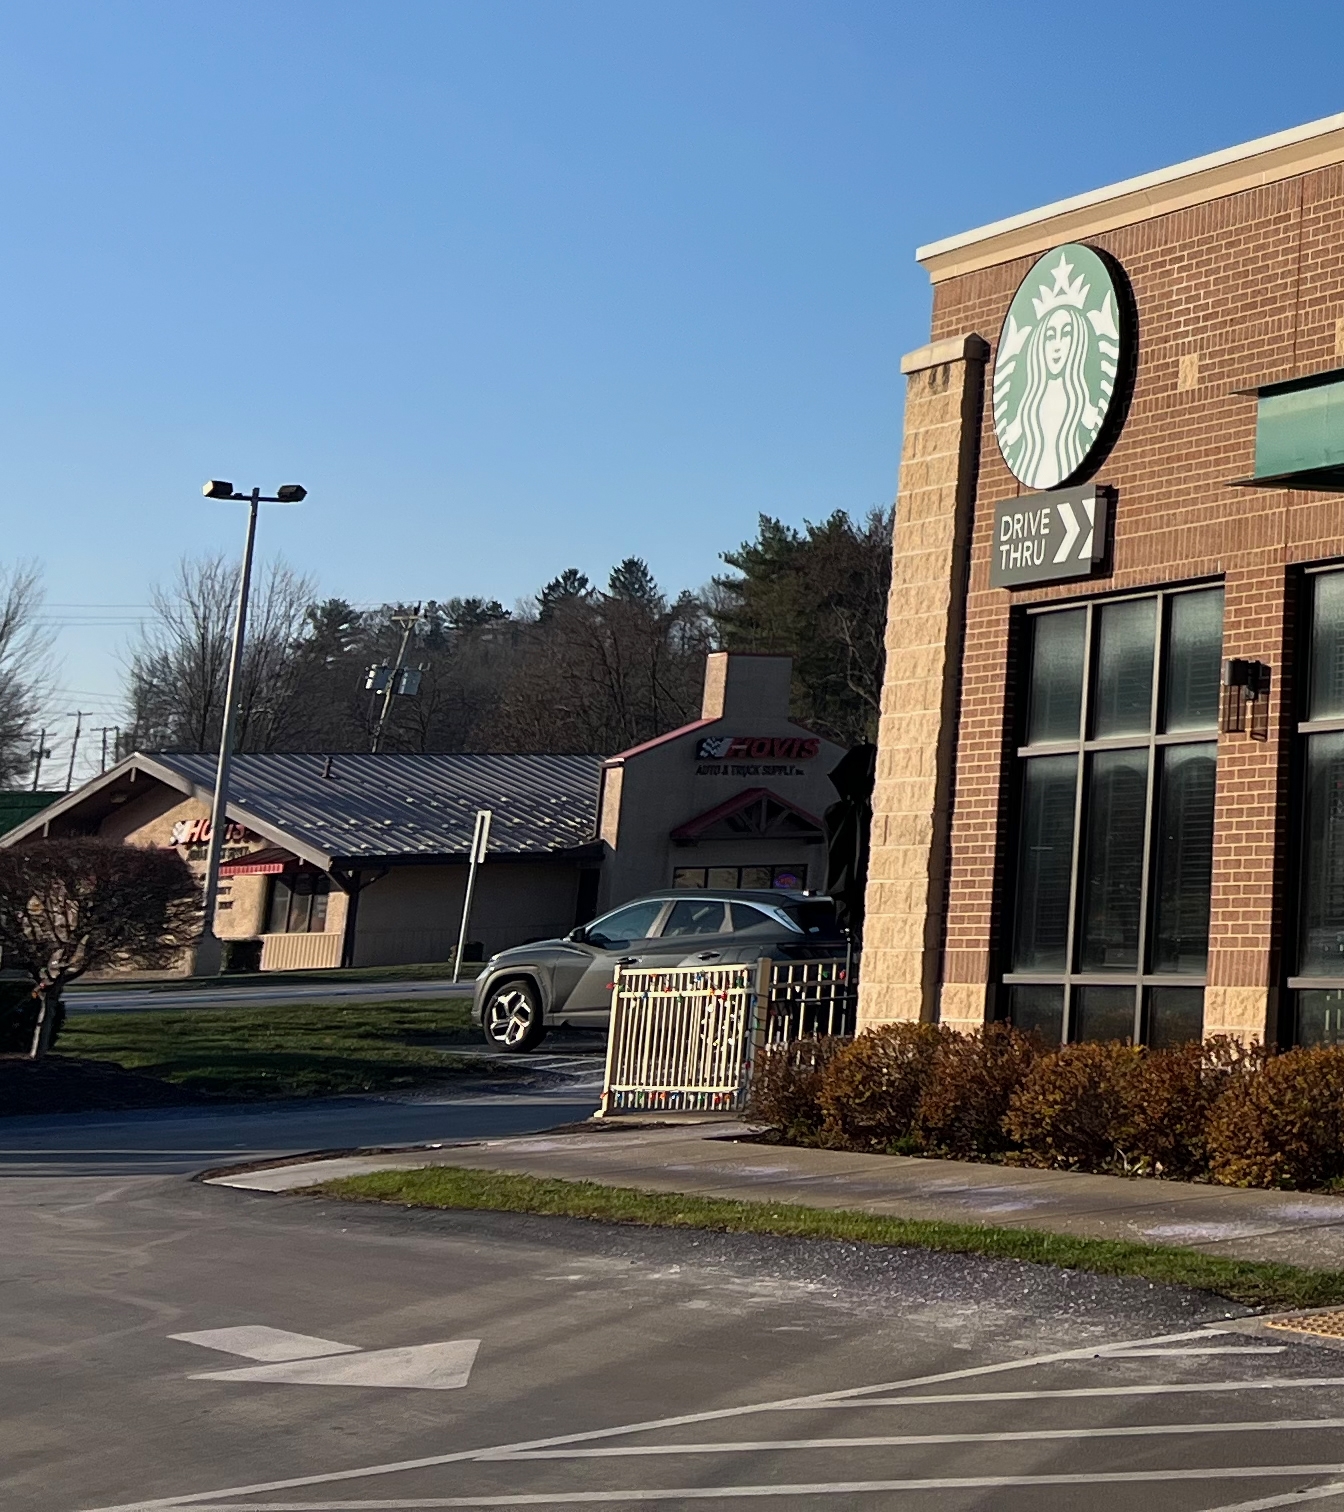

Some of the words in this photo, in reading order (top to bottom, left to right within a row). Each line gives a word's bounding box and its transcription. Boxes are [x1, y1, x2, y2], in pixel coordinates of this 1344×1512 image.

[1001, 508, 1050, 541] DRIVE
[1000, 539, 1045, 569] THRU
[725, 737, 820, 759] HOVIS
[731, 765, 760, 777] TRUCK
[762, 764, 795, 775] SUPPLY
